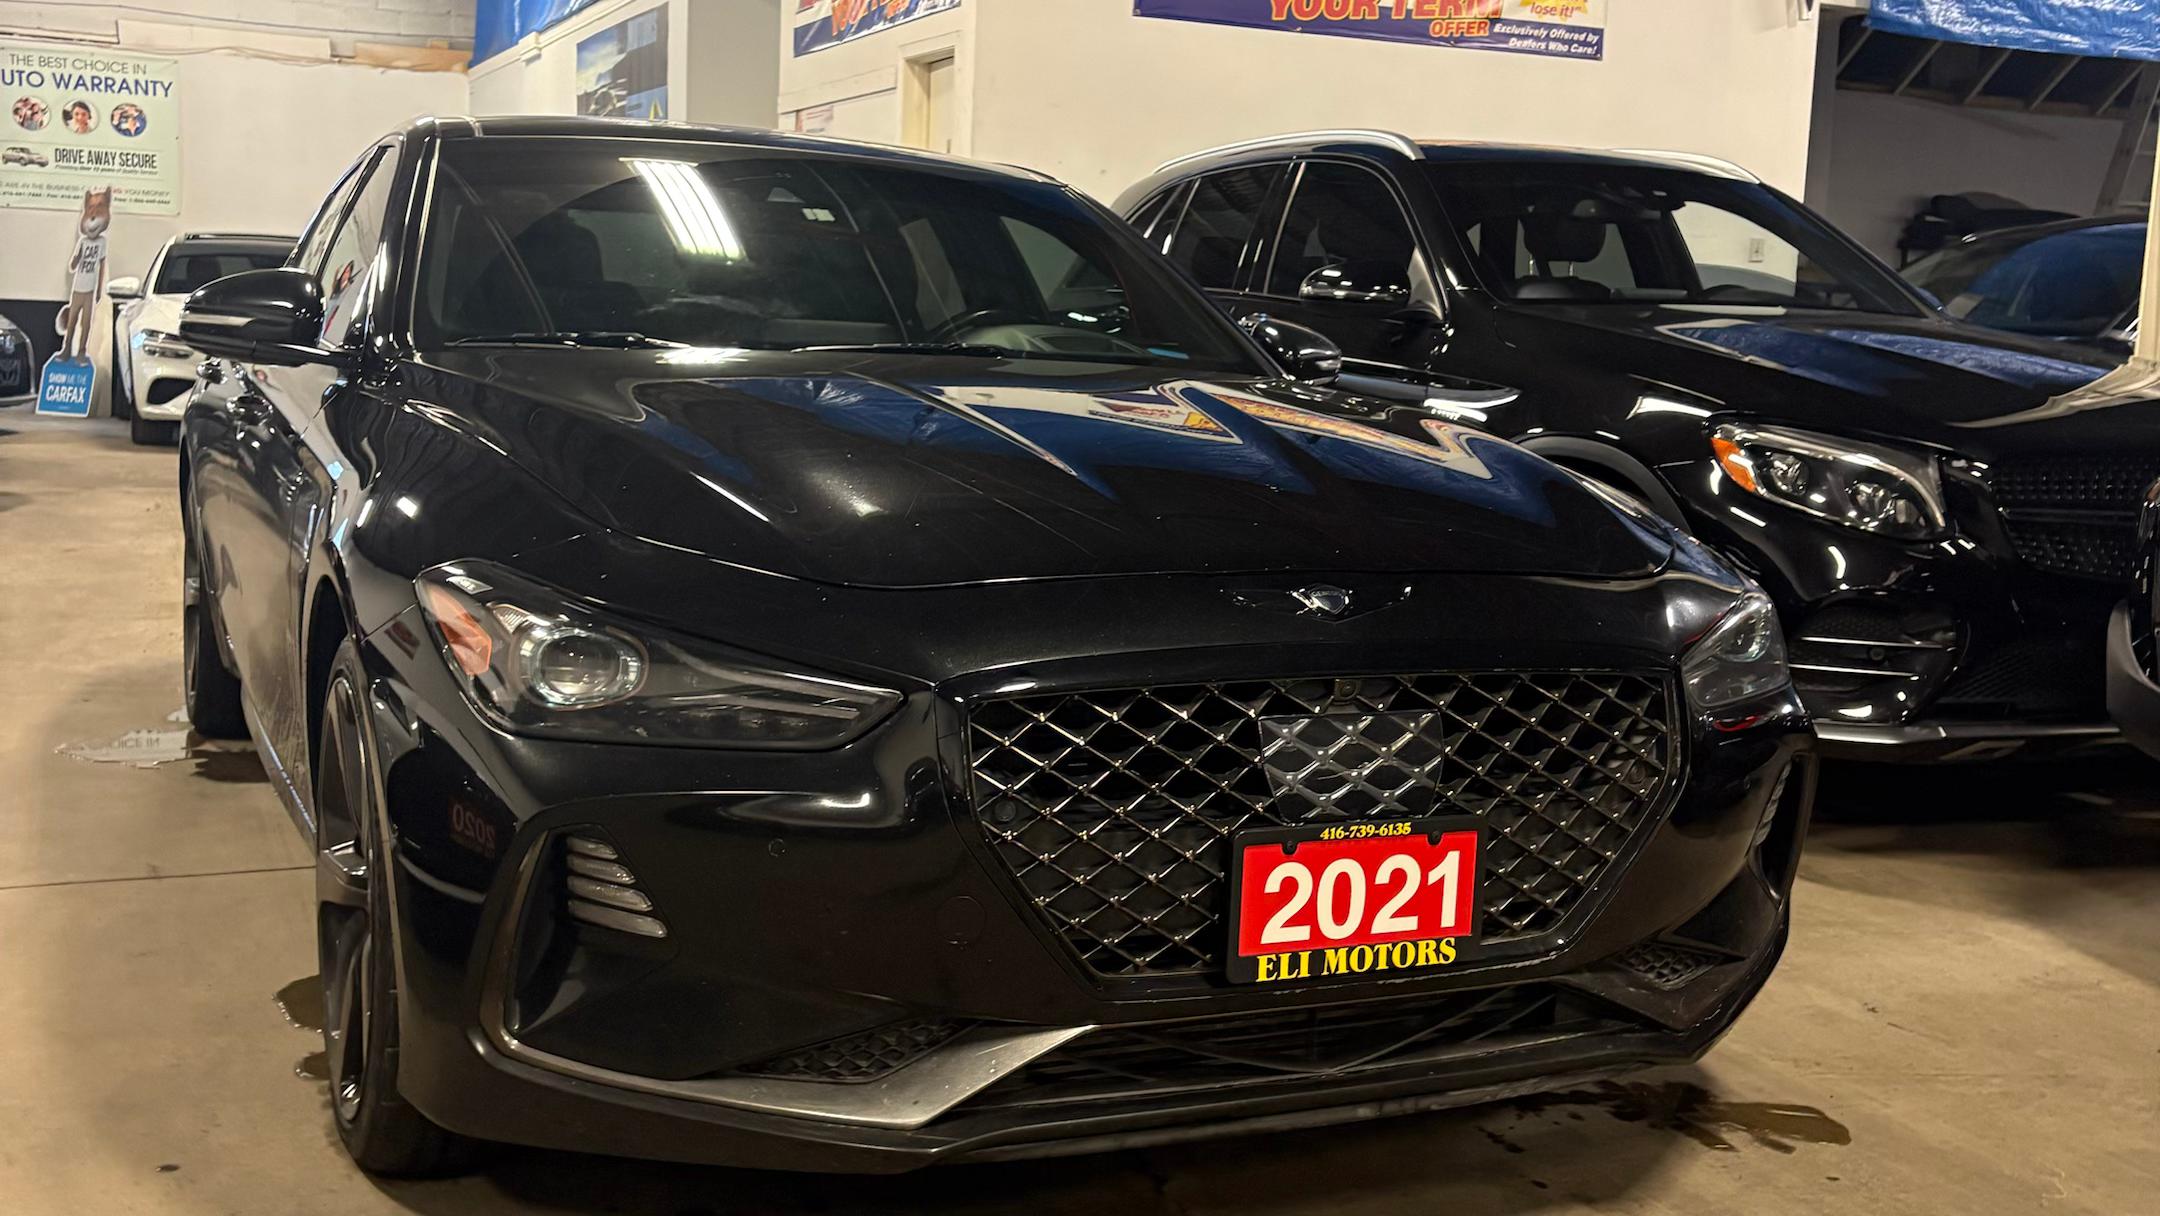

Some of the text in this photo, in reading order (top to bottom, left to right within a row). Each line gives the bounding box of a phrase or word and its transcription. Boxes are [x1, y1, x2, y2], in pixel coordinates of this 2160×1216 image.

[1271, 0, 1380, 20] YOUR
[1531, 2, 1559, 15] lose
[1429, 19, 1490, 37] OFFER
[1493, 24, 1599, 43] Exclusively Offered by
[1548, 41, 1569, 52] Who
[1571, 44, 1597, 55] Care!
[9, 53, 147, 75] THE BEST CHOICE IN
[1, 69, 173, 98] UTO WARRANTY
[54, 148, 157, 169] DRIVE AWAY SECURE
[84, 245, 99, 259] CAR
[81, 260, 96, 273] FOX
[46, 384, 87, 404] CARFAX
[1319, 822, 1412, 840] 416-739-6135
[1260, 850, 1461, 945] 2021
[1256, 937, 1457, 983] ELI MOTORS
